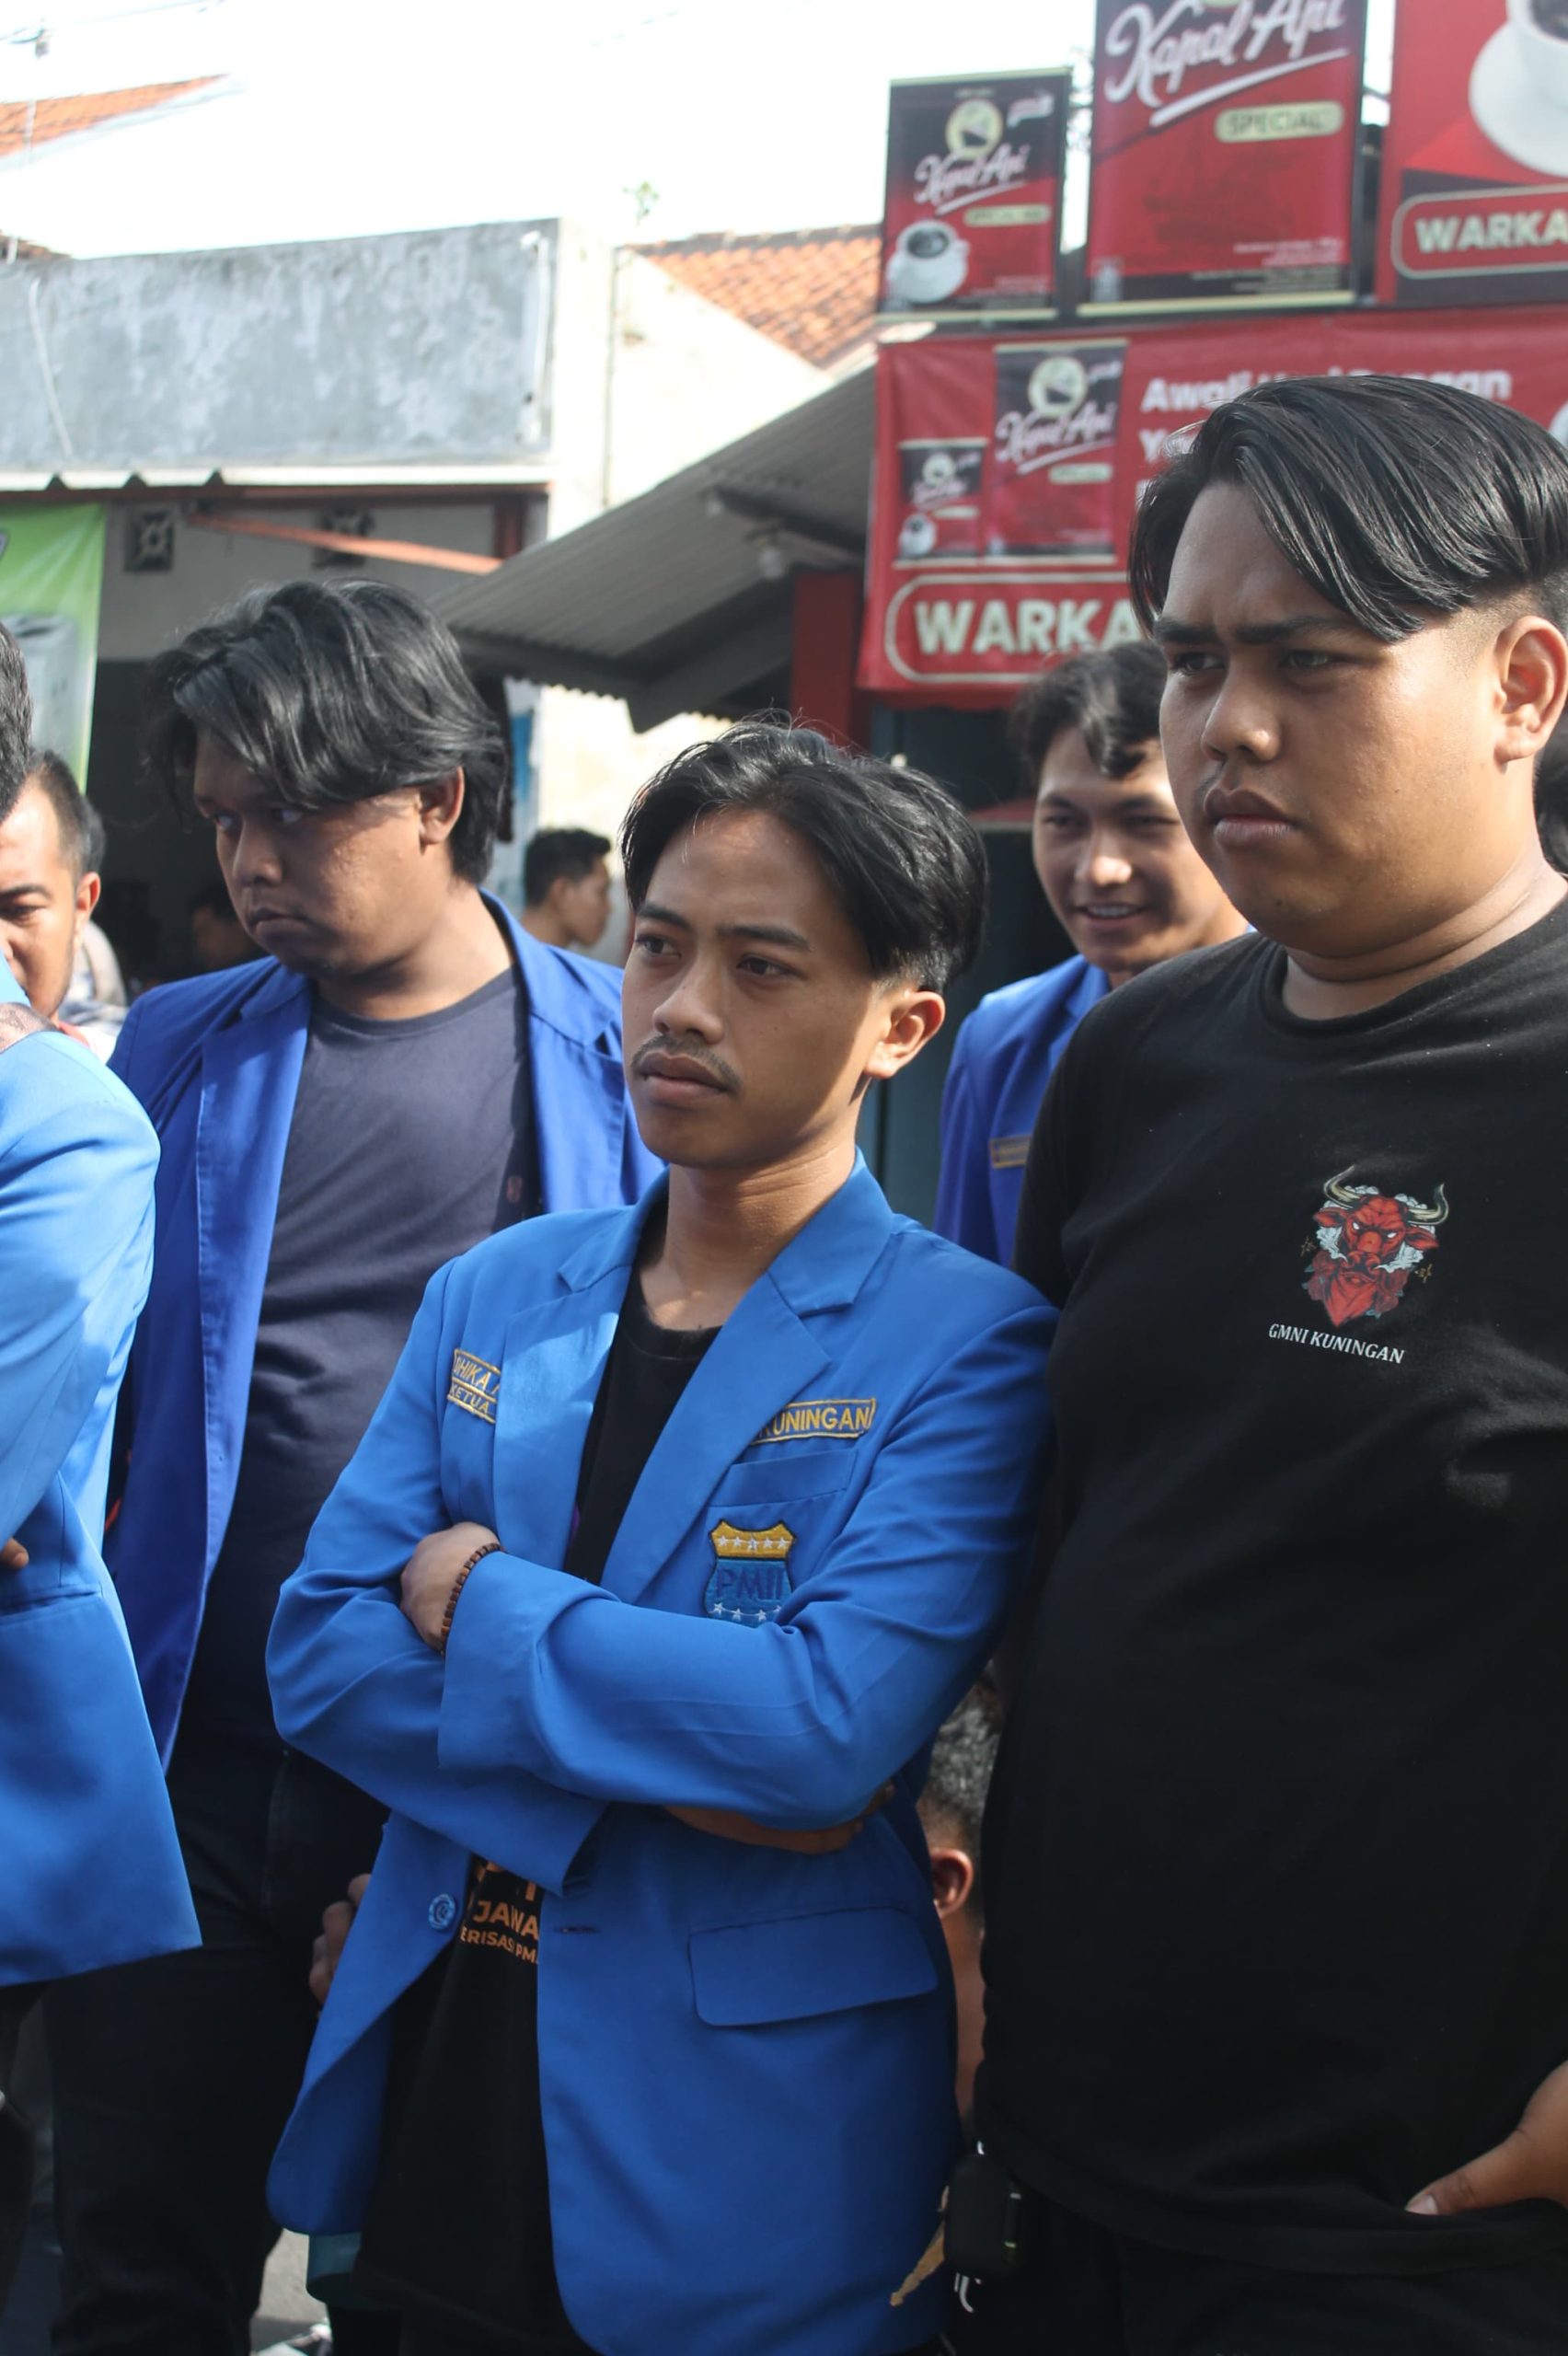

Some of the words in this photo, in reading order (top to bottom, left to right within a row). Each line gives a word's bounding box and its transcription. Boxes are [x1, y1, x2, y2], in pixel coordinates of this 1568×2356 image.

[1268, 1322, 1309, 1344] GMNI
[1309, 1331, 1405, 1364] KUNINGAN
[449, 1383, 490, 1415] KETUA
[760, 1406, 870, 1437] UNINGAN
[716, 1566, 784, 1600] PMII
[472, 1900, 539, 1941] JAWA
[515, 1943, 539, 1965] PM
